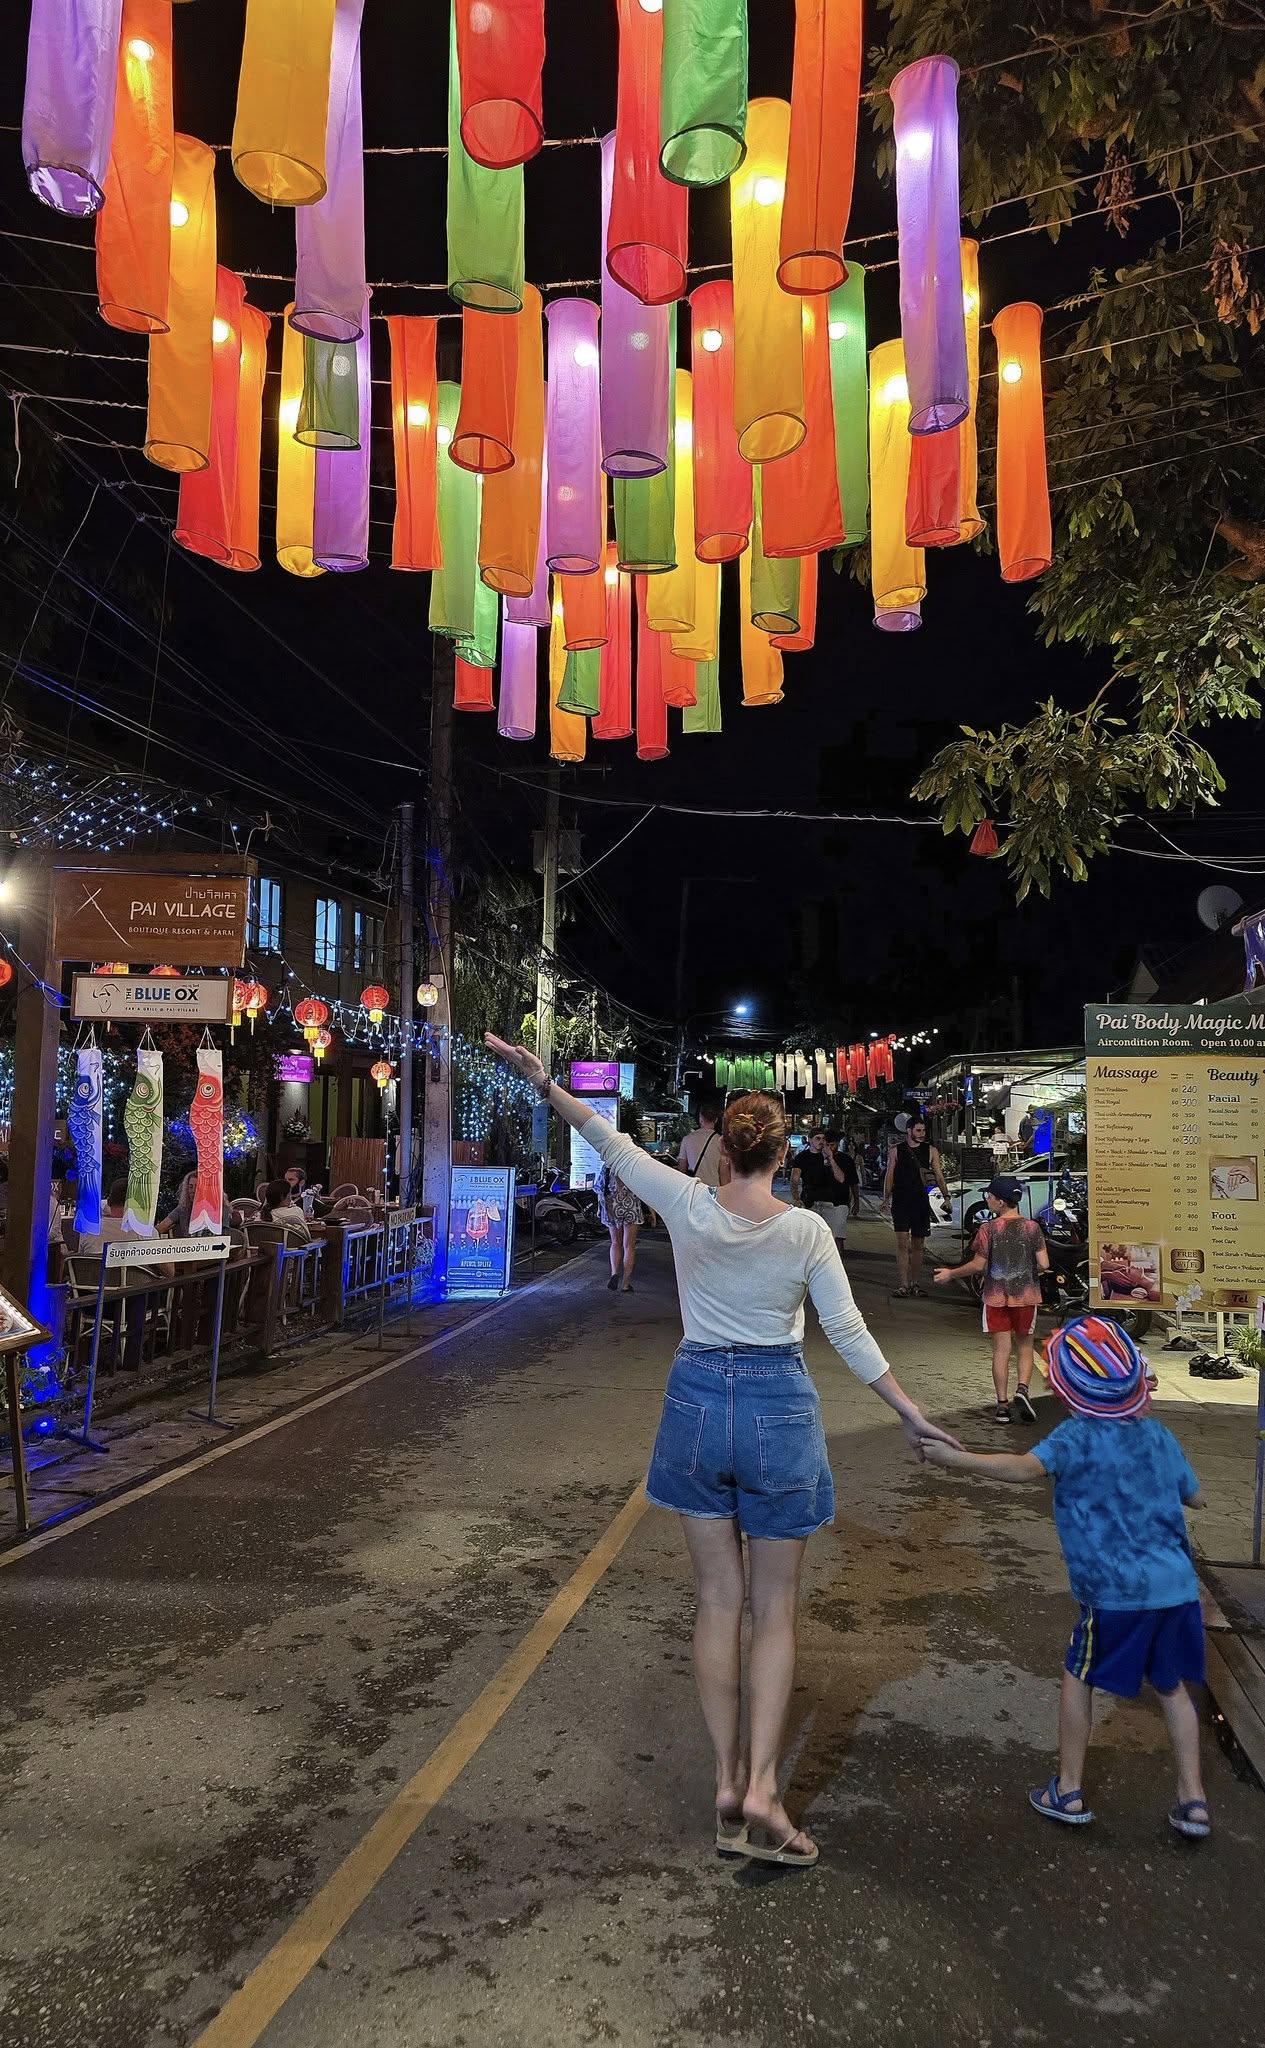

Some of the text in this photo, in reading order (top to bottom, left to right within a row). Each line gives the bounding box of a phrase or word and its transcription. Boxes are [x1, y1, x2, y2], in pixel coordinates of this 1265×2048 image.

[130, 901, 236, 920] PAI VILLAGE
[128, 926, 168, 934] BOUTIQUE
[134, 987, 171, 1000] BLUE
[175, 988, 199, 1001] OX
[1095, 1013, 1129, 1030] Pai
[1131, 1012, 1182, 1036] Body
[1183, 1013, 1243, 1036] Magic
[1097, 1038, 1160, 1046] Aircondition
[1161, 1039, 1193, 1047] Room.
[1200, 1039, 1227, 1049] Open
[1229, 1039, 1254, 1047] 10.00
[1093, 1066, 1159, 1084] Massage
[1207, 1069, 1260, 1086] Beauty
[1182, 1085, 1197, 1093] 240
[1181, 1098, 1198, 1107] 300
[1208, 1094, 1240, 1103] Facial
[1182, 1124, 1198, 1132] 240
[1183, 1136, 1199, 1145] 300
[1212, 1211, 1237, 1220] Foot
[1231, 1294, 1248, 1303] Tel
